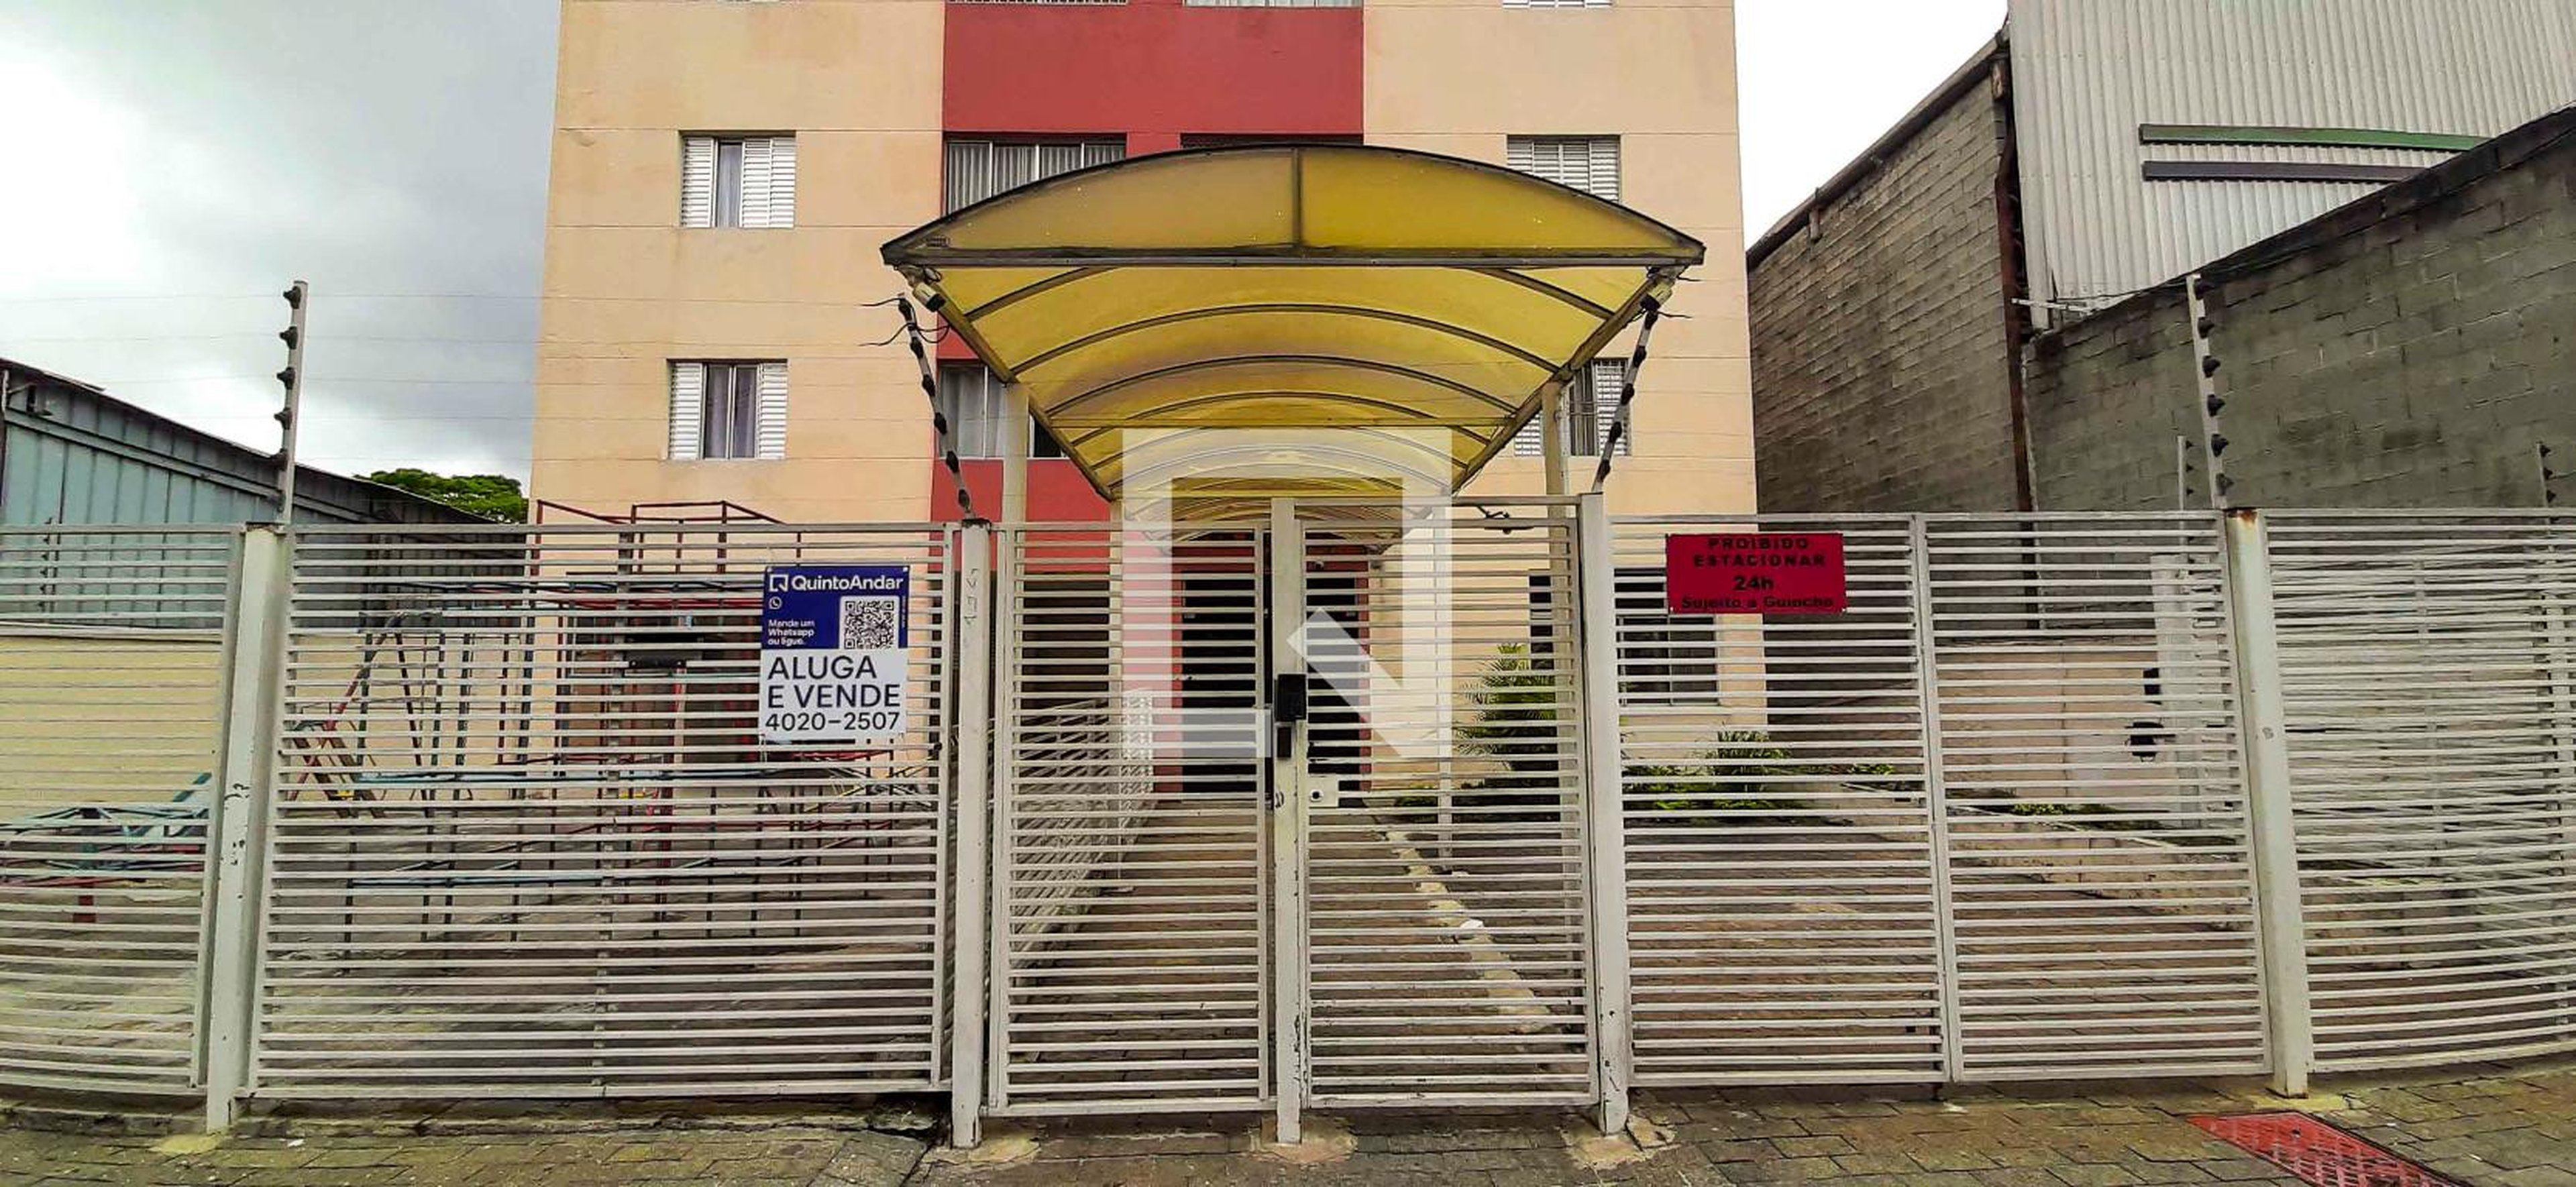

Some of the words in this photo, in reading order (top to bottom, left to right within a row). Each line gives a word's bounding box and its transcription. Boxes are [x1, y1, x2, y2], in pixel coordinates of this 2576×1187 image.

[1707, 537, 1809, 550] PROIBIDO
[1693, 554, 1825, 567] ESTACIONAR
[792, 575, 903, 591] QuintoAndar
[1733, 575, 1773, 591] 24h
[1682, 596, 1741, 609] Sujeito
[1748, 600, 1757, 608] a
[1764, 596, 1833, 608] Guincho
[768, 619, 799, 627] Mande
[767, 655, 877, 679] ALUGA
[768, 685, 784, 708] E
[794, 684, 900, 708] VENDE
[765, 712, 900, 731] 4020-2507
